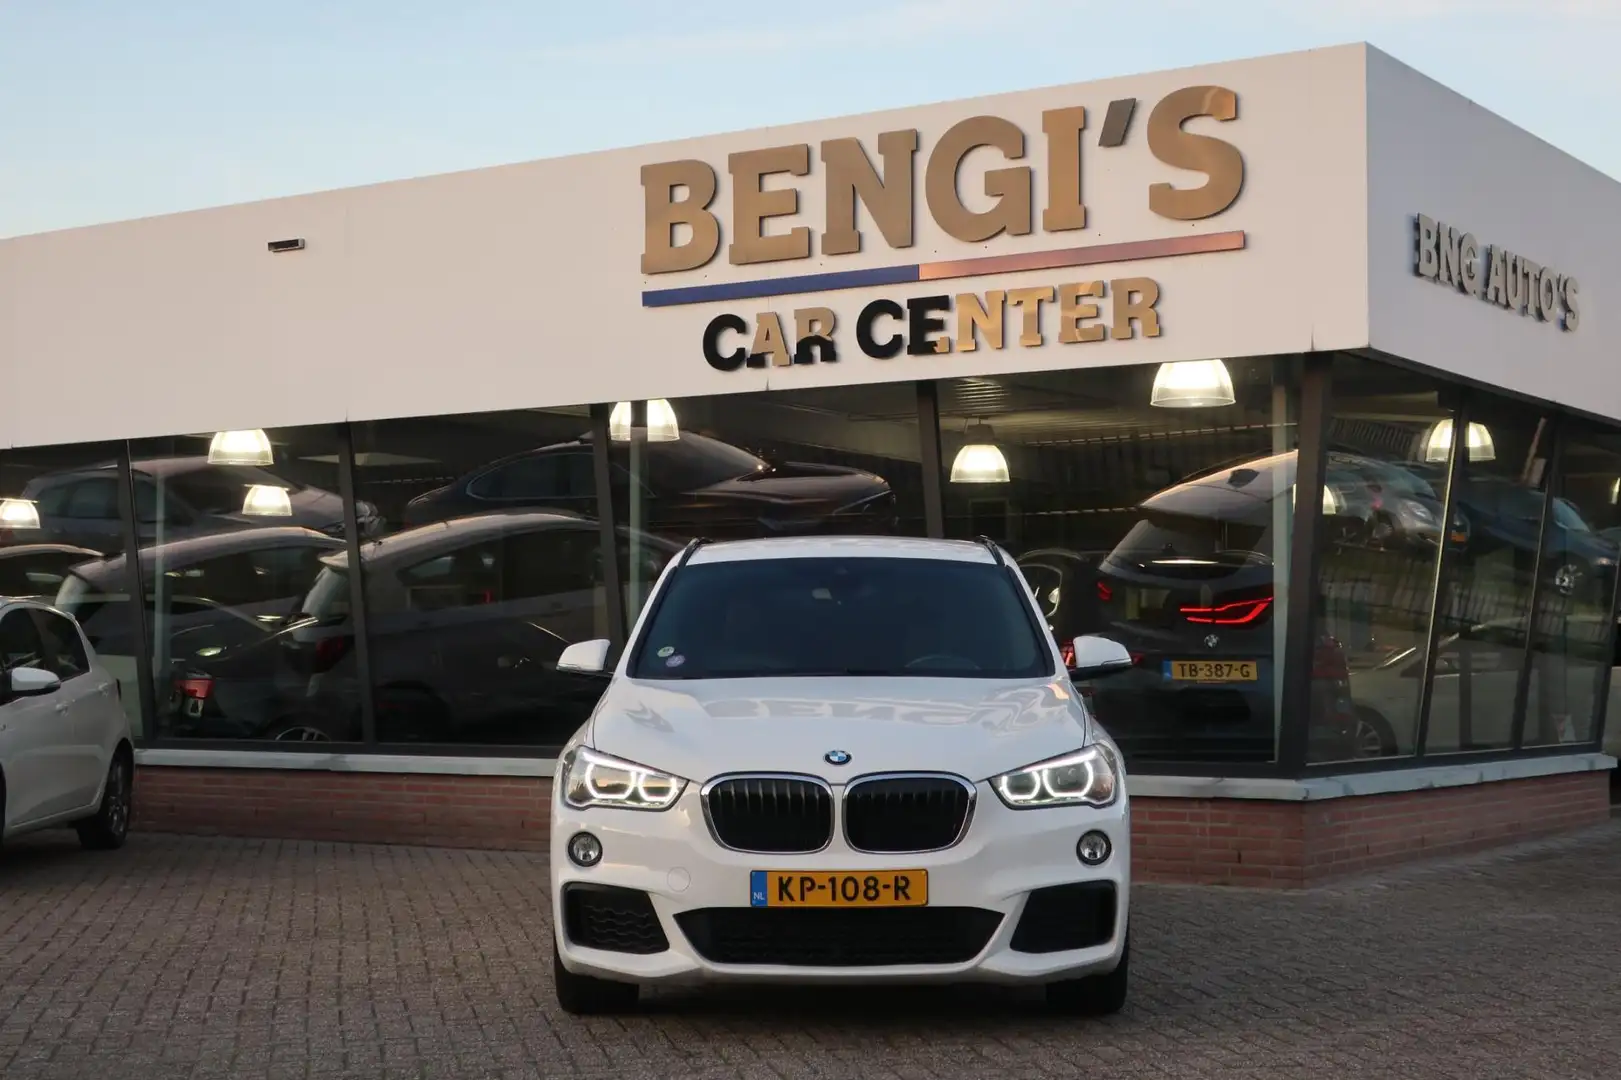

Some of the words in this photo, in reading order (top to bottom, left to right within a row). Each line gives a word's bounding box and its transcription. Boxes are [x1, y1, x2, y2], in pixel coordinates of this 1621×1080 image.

[641, 85, 1244, 275] BENGI'S
[1413, 212, 1481, 299] BNG
[1485, 243, 1580, 332] AUTO'S
[702, 306, 838, 371] CAR
[855, 276, 1161, 359] CENTER
[1178, 663, 1250, 678] TB-387-G
[753, 891, 765, 900] NL
[778, 875, 911, 902] KP-108-R
